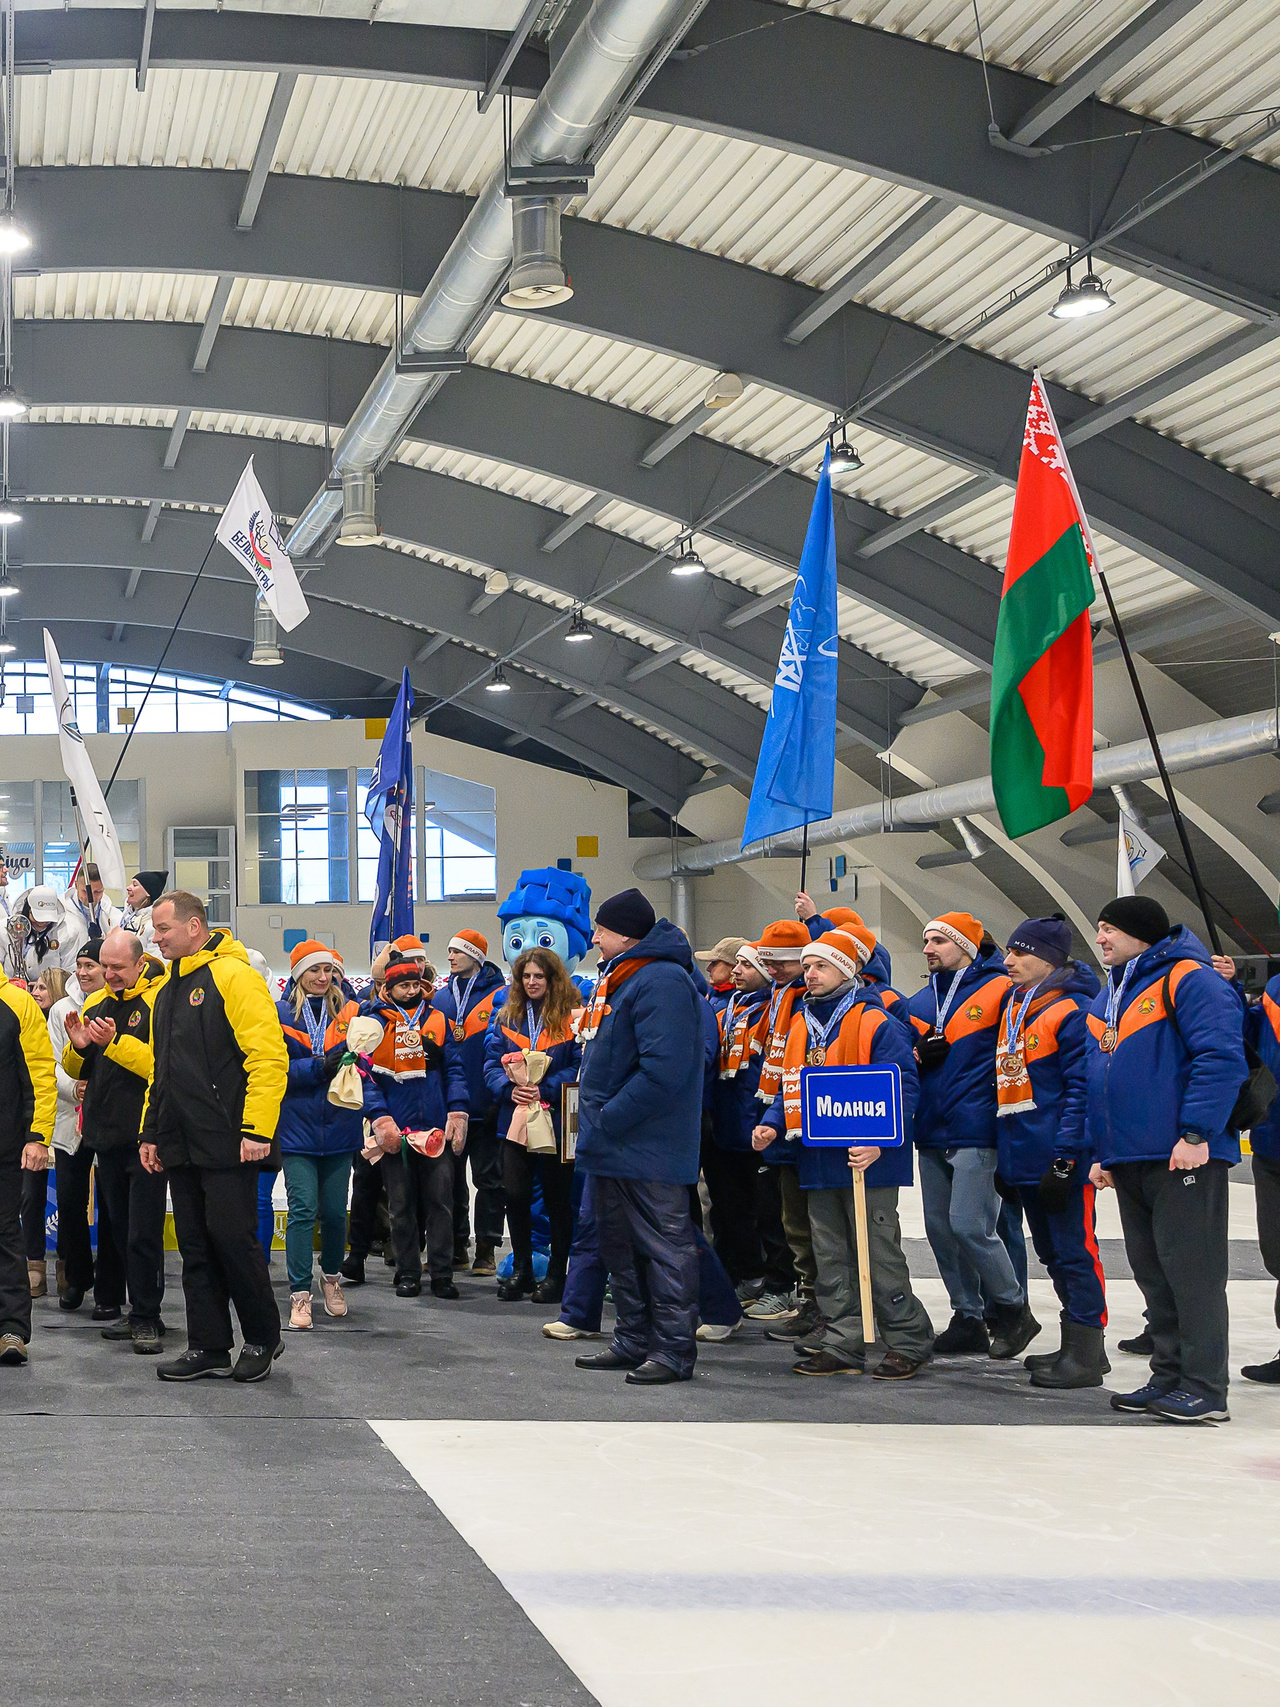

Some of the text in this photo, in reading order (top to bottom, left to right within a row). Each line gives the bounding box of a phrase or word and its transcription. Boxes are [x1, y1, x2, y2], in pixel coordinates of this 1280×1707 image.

[230, 530, 275, 592] БЕЛЫЕ ТИГРЫ
[1014, 940, 1036, 951] MOAX
[816, 1094, 887, 1118] Молния
